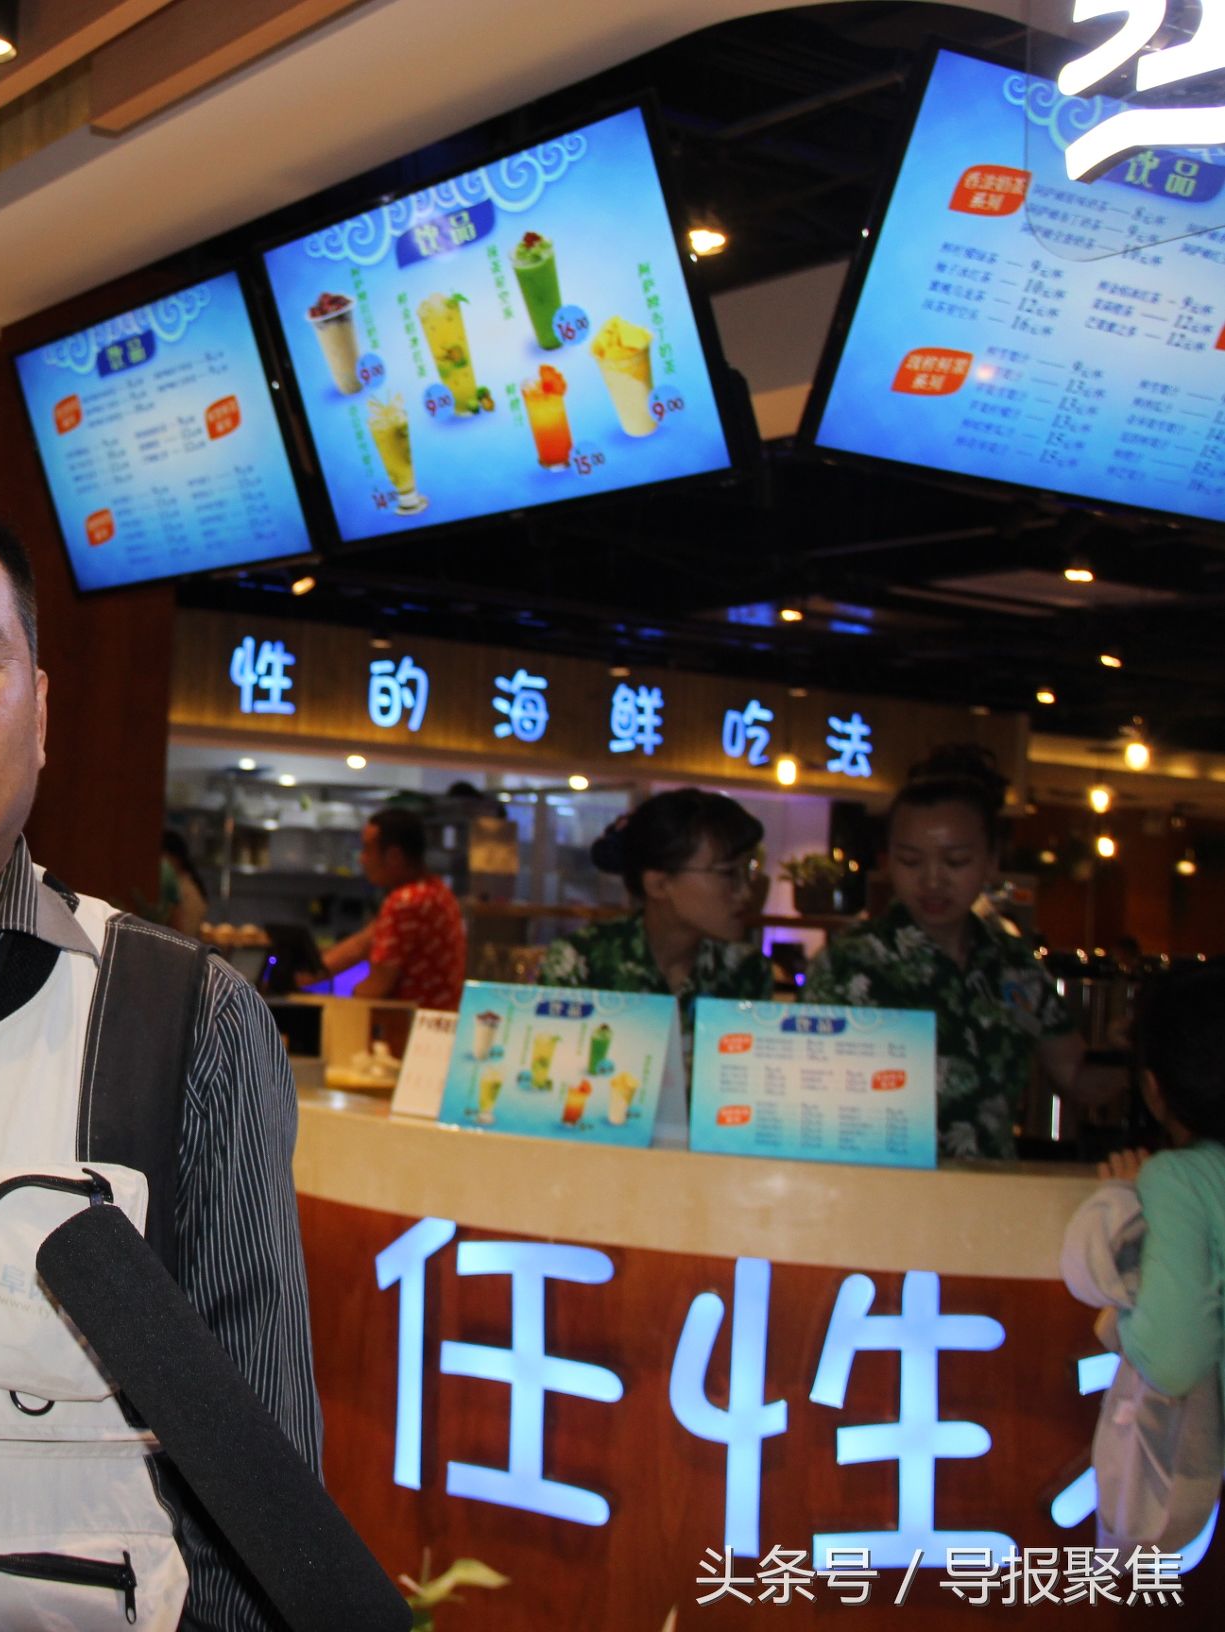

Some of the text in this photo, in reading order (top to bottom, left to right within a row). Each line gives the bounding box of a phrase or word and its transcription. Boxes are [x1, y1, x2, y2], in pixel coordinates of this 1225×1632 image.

[1125, 150, 1199, 198] 饮品
[414, 210, 478, 258] 饮品
[230, 636, 873, 778] 性的海鲜吃法
[376, 1216, 1219, 1575] 任性
